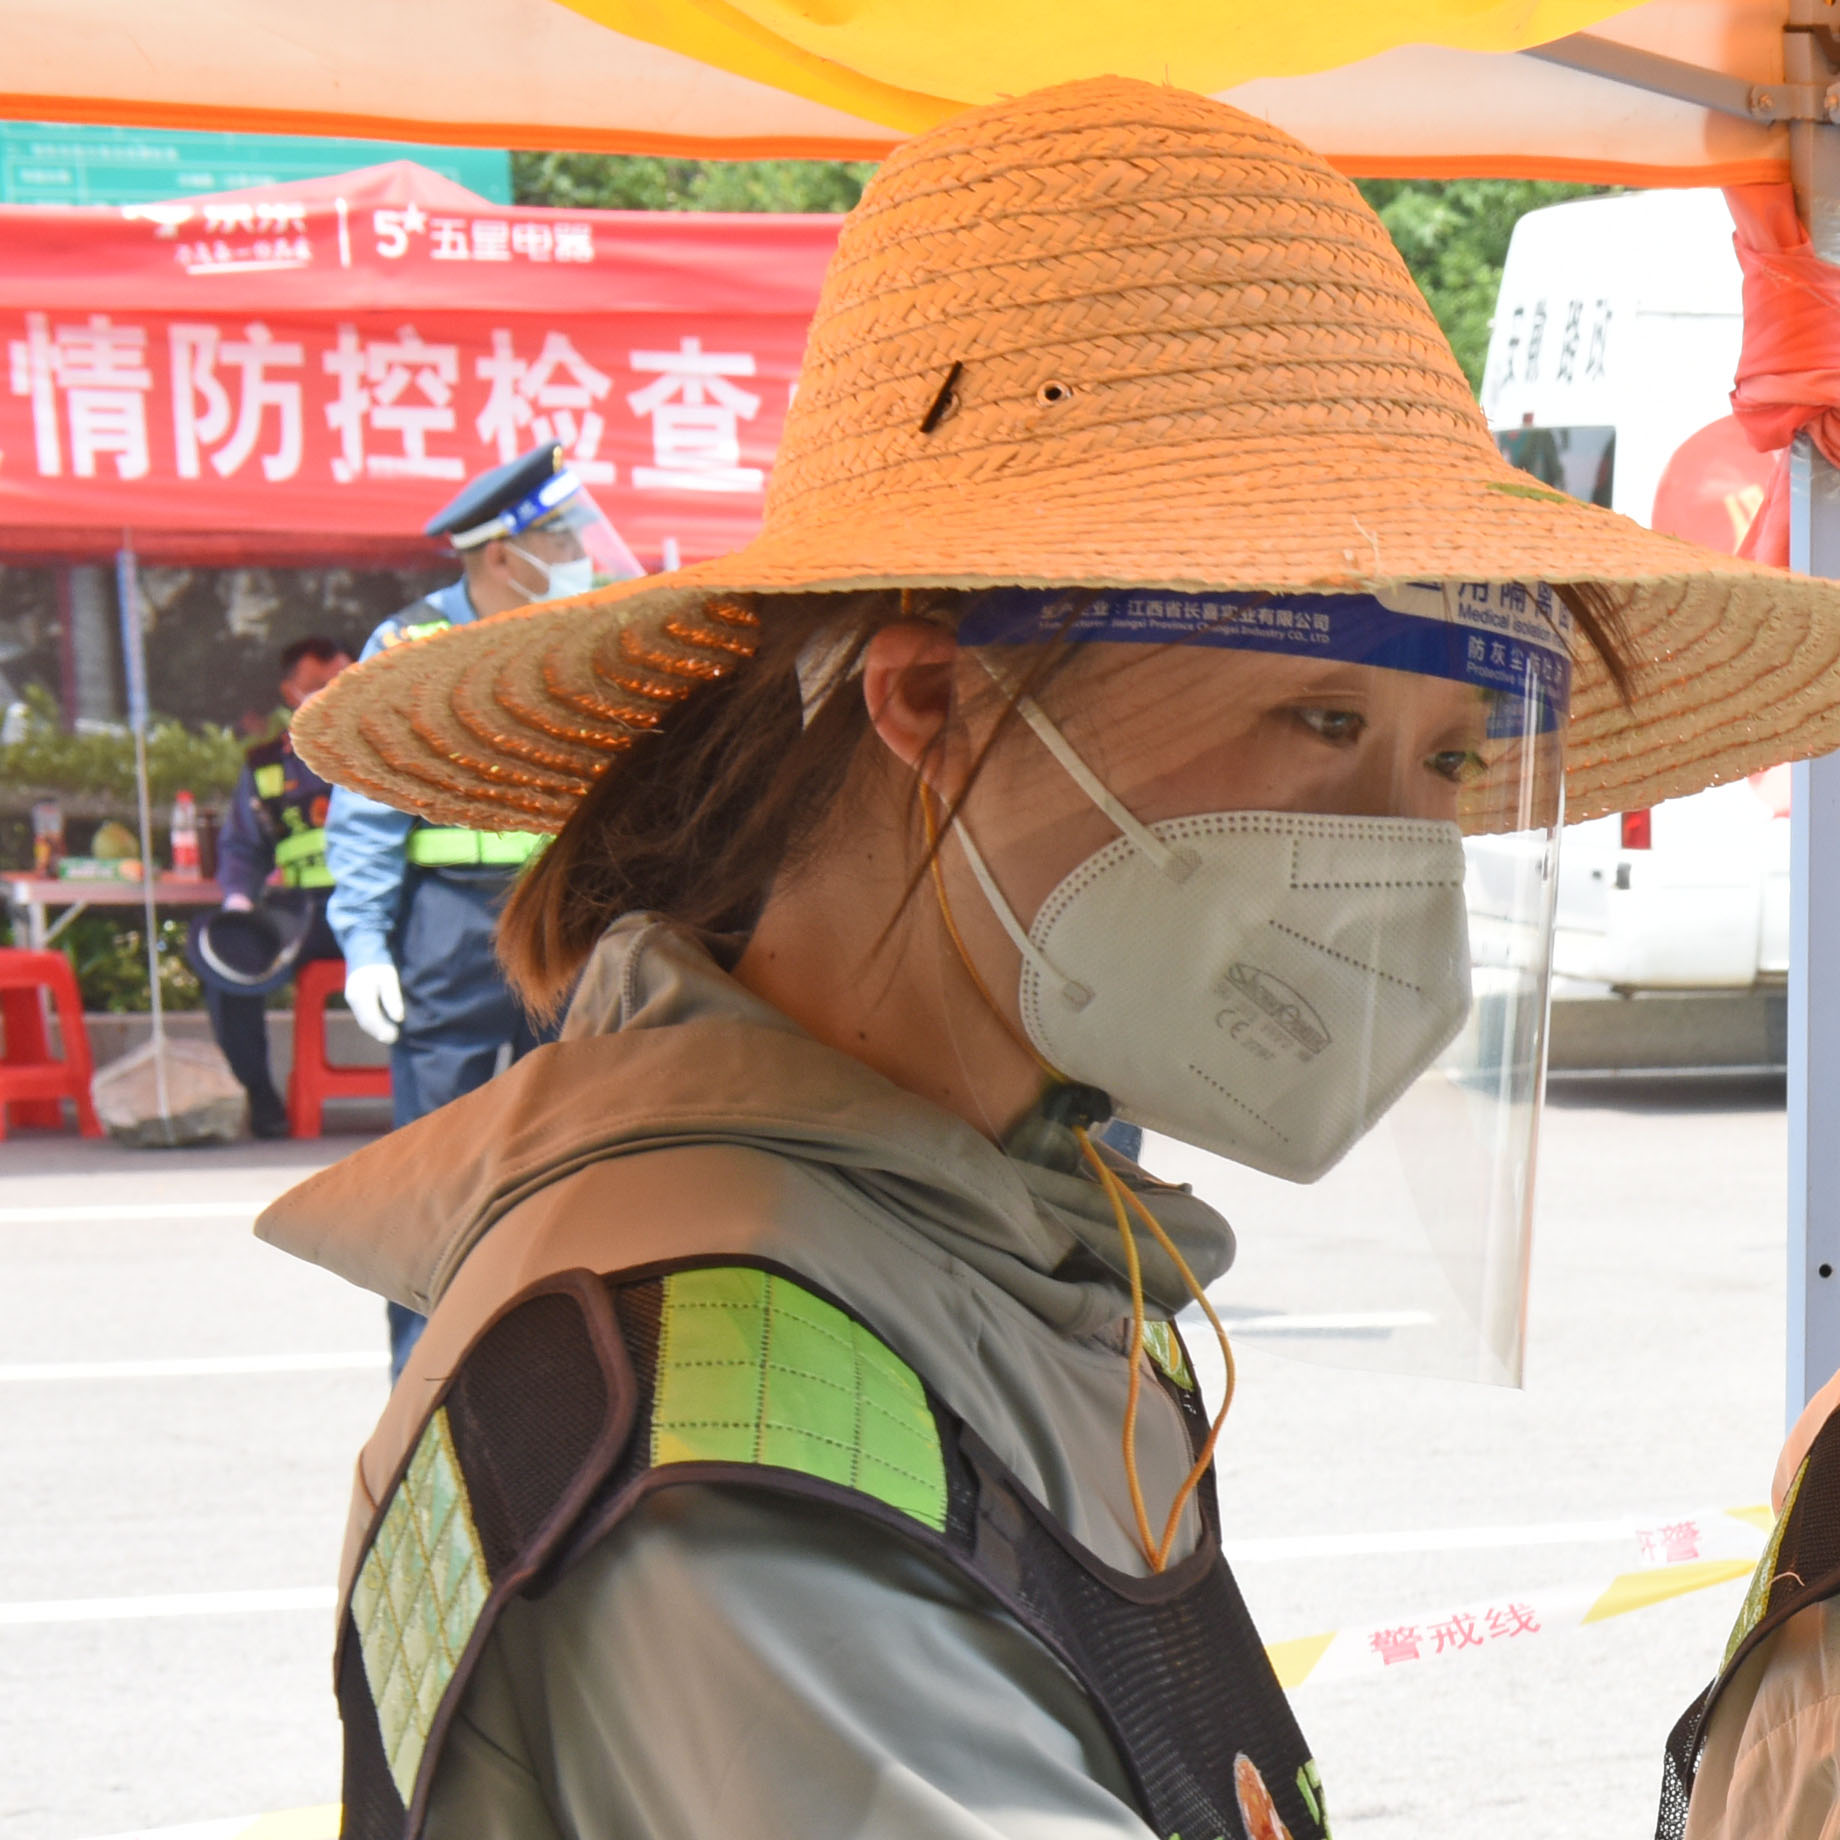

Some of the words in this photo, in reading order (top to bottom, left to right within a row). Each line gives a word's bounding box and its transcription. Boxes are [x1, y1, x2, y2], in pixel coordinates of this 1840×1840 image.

[430, 218, 595, 262] 五星电器
[4, 310, 767, 492] 情防控检查
[1368, 1602, 1542, 1667] 警戒线
